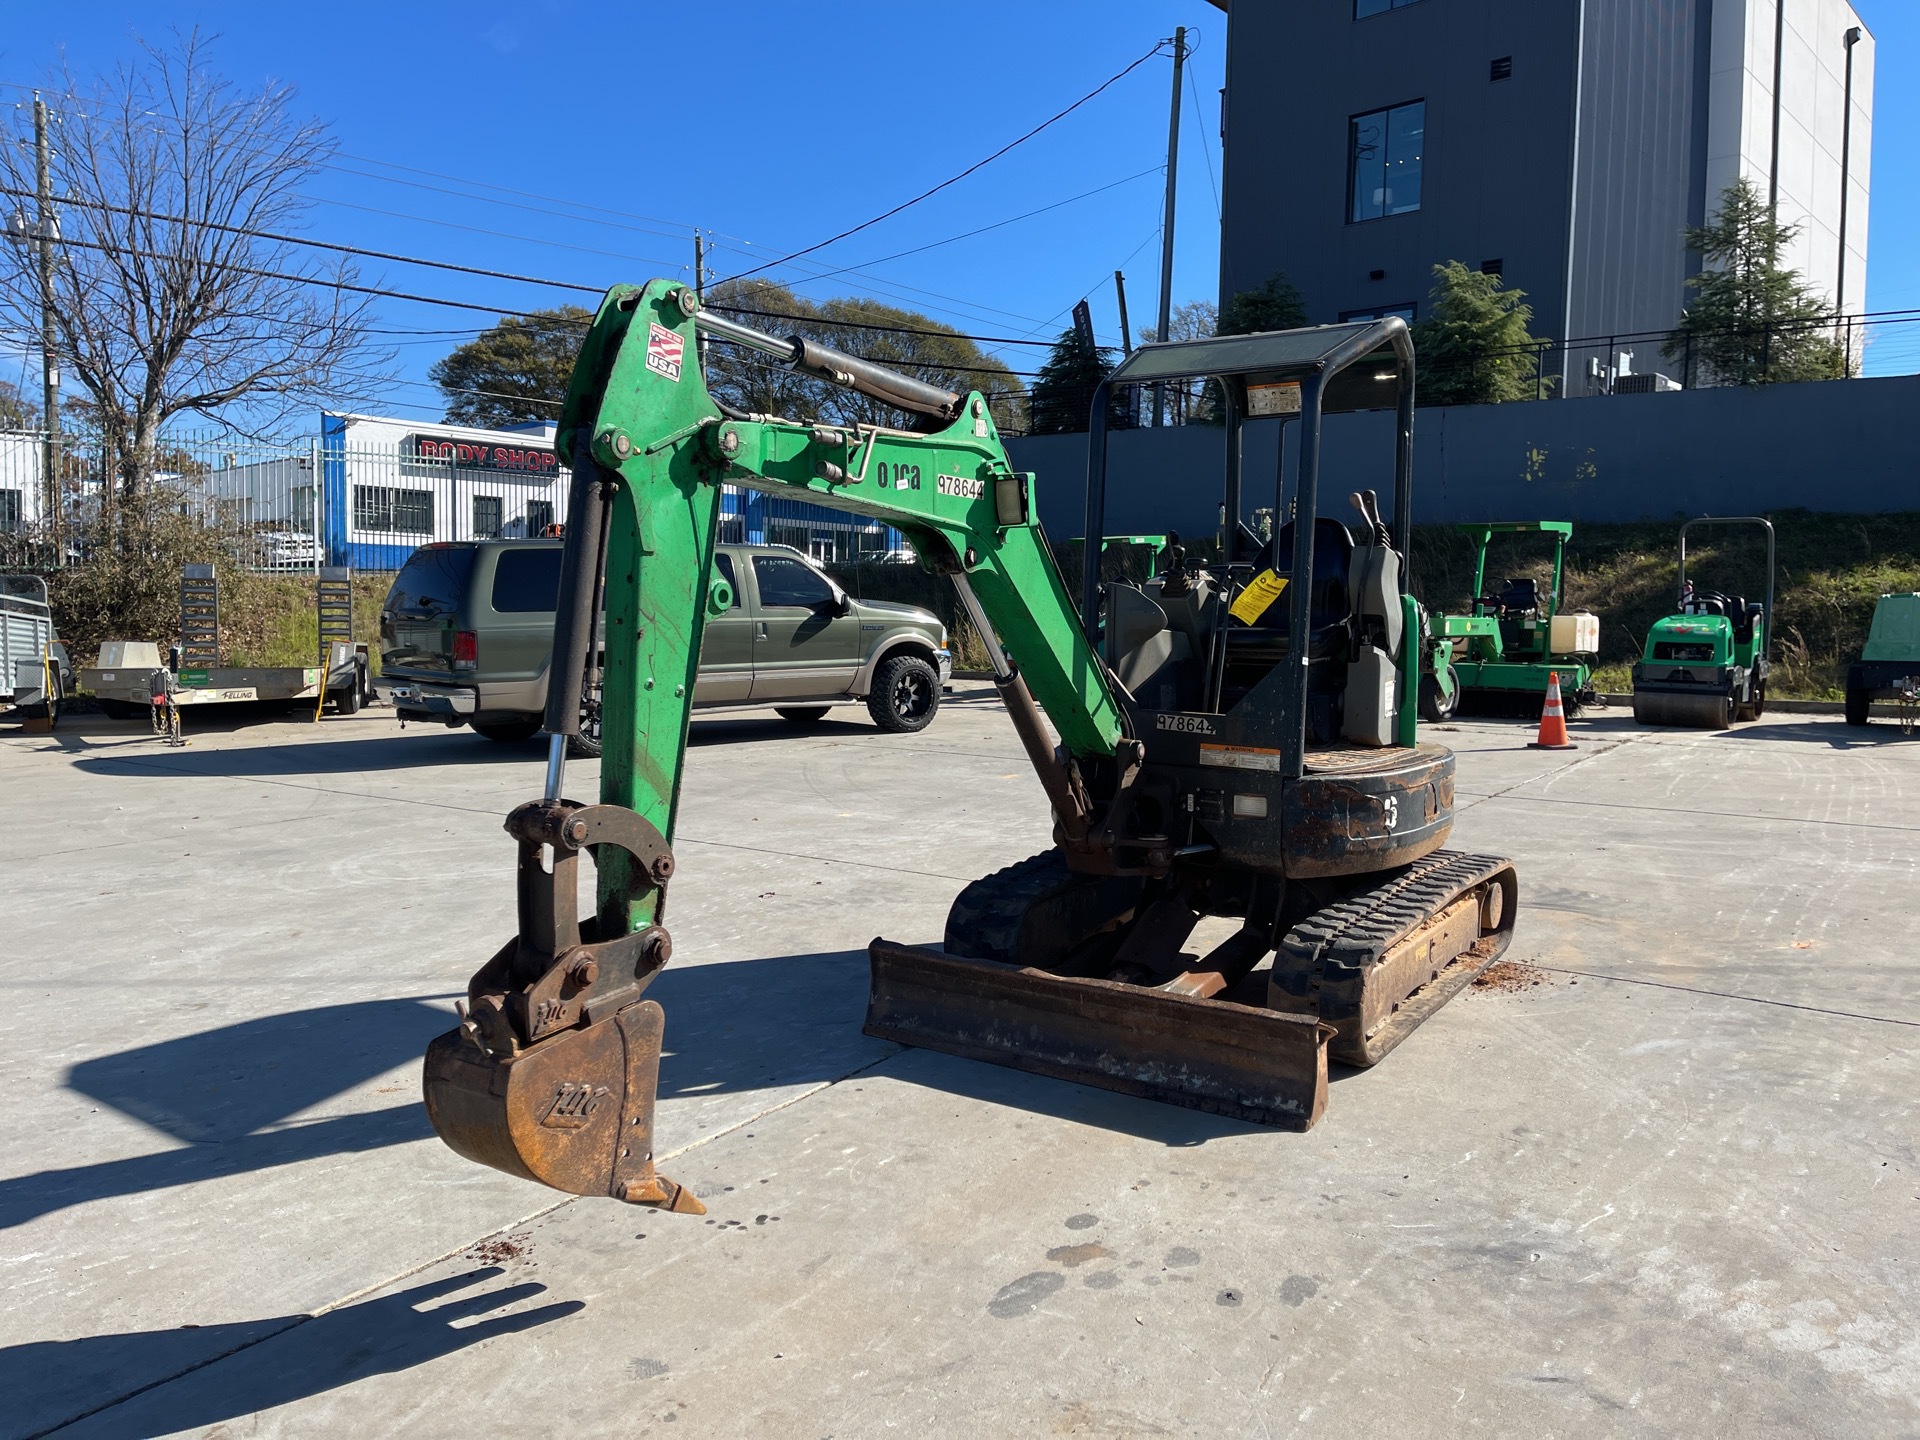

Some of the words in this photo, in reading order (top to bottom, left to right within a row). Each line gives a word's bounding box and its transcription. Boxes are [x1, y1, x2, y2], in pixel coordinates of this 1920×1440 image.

[648, 354, 678, 376] USA
[421, 440, 488, 466] BODY
[494, 447, 556, 471] SHOP
[938, 475, 984, 499] 978644
[222, 690, 253, 699] FELLING
